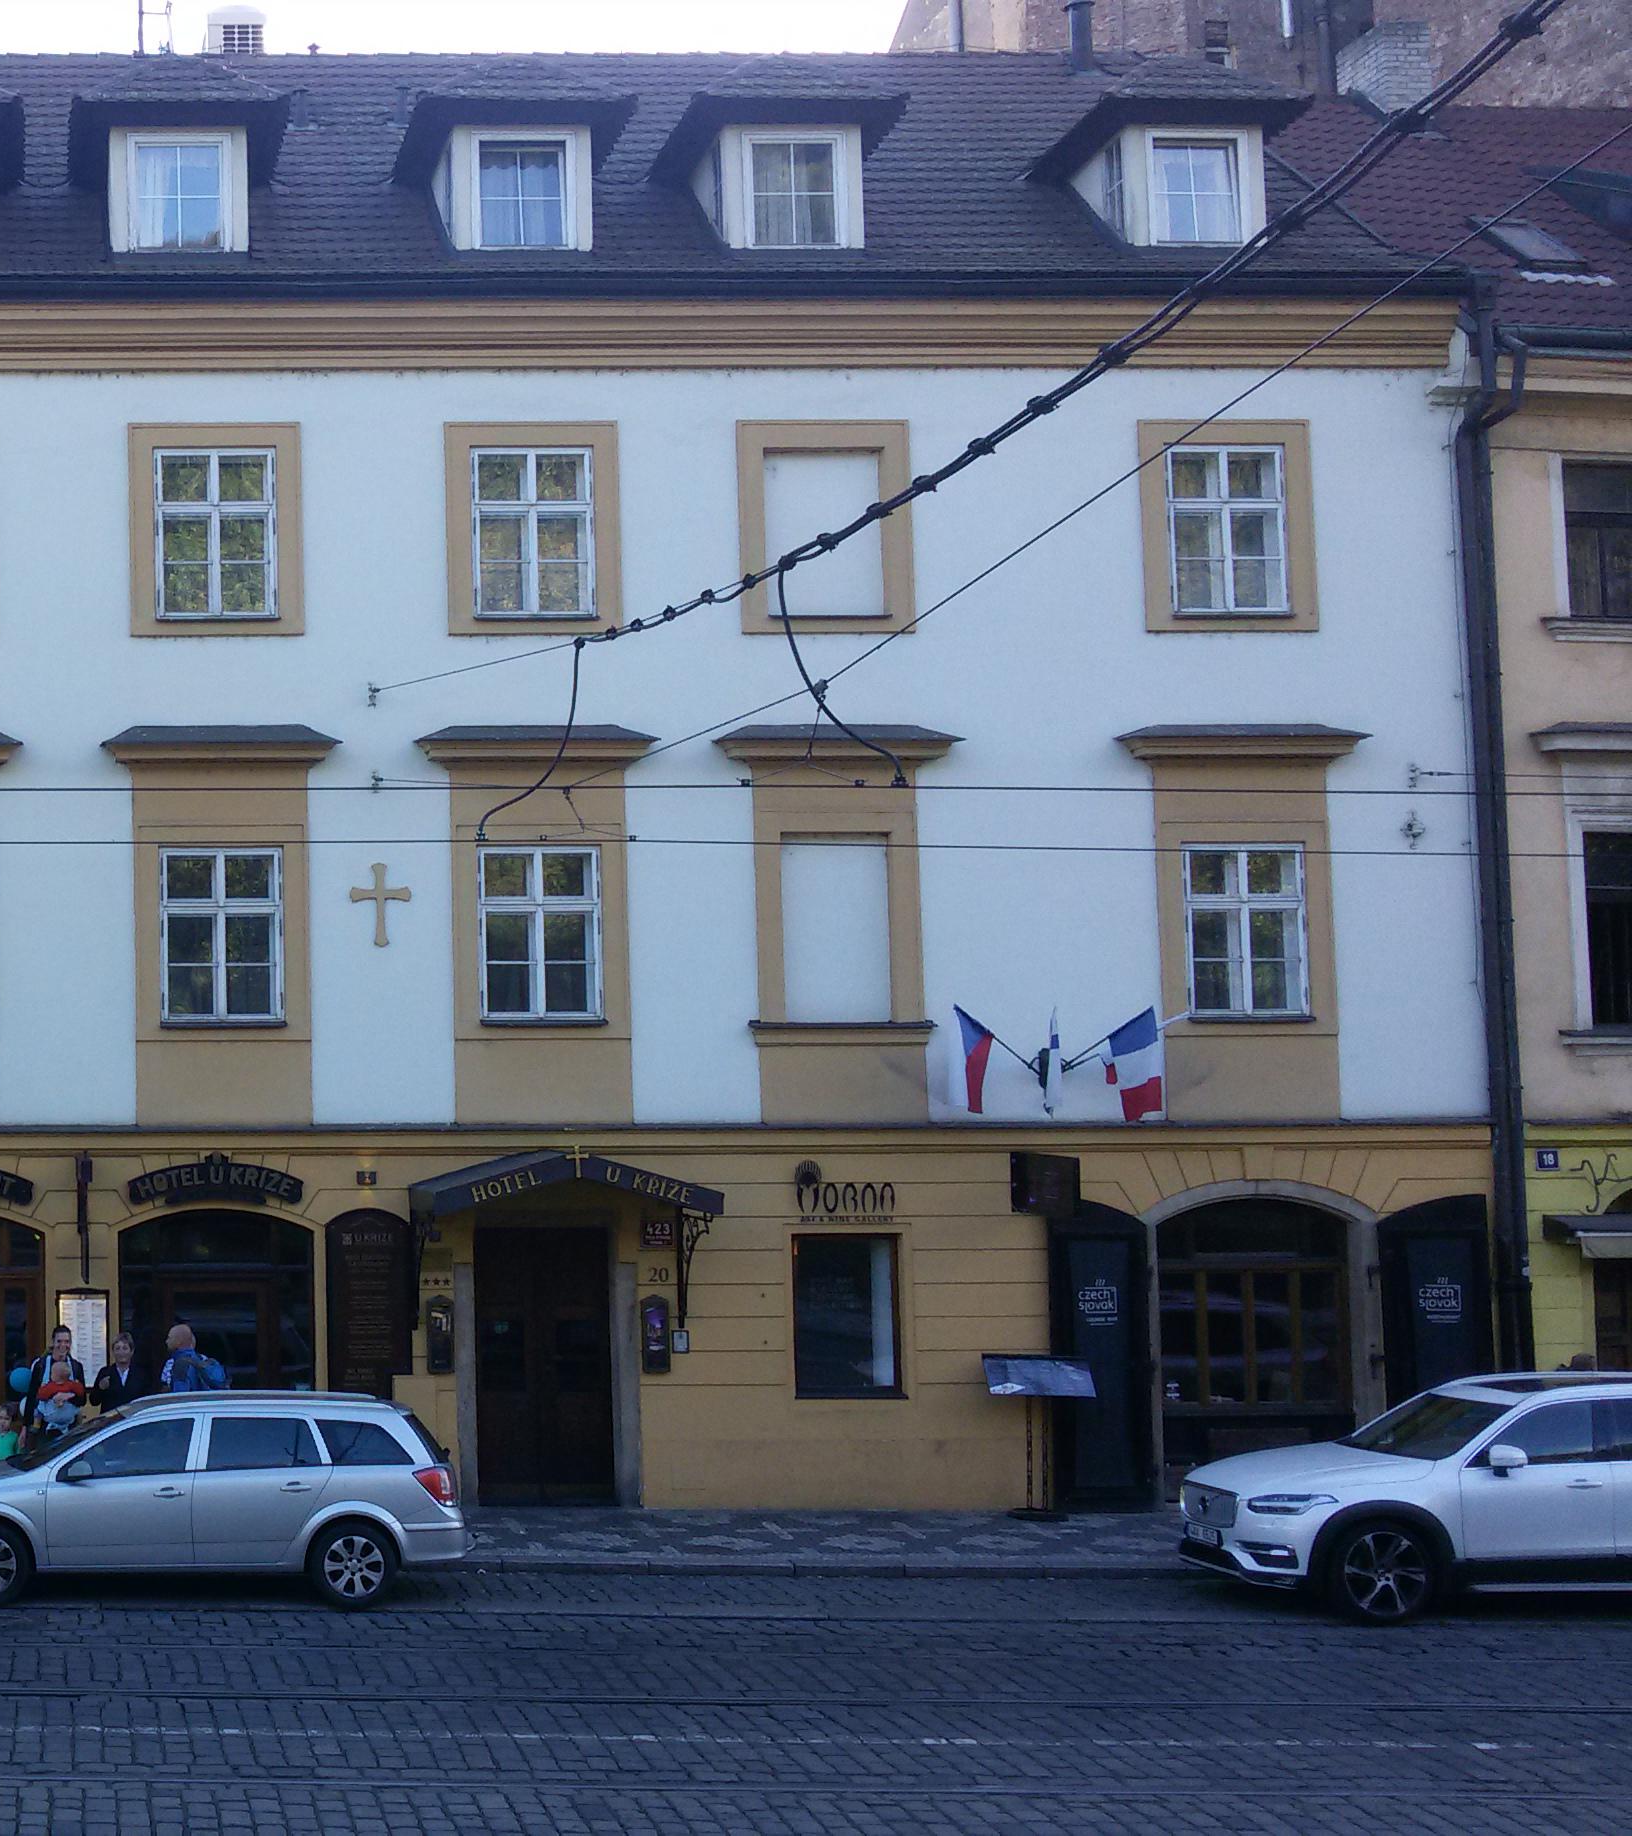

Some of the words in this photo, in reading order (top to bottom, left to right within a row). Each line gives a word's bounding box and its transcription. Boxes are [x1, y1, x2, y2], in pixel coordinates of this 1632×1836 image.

[1542, 1153, 1555, 1165] 18
[135, 1167, 206, 1199] HOTEL
[209, 1165, 226, 1185] U
[470, 1170, 542, 1203] HOTEL
[604, 1165, 622, 1184] U
[646, 1223, 671, 1235] 423
[648, 1267, 669, 1283] 20
[1078, 1290, 1111, 1300] czech
[1419, 1287, 1454, 1297] czech
[1078, 1301, 1114, 1311] slovak
[1418, 1298, 1458, 1308] slovak
